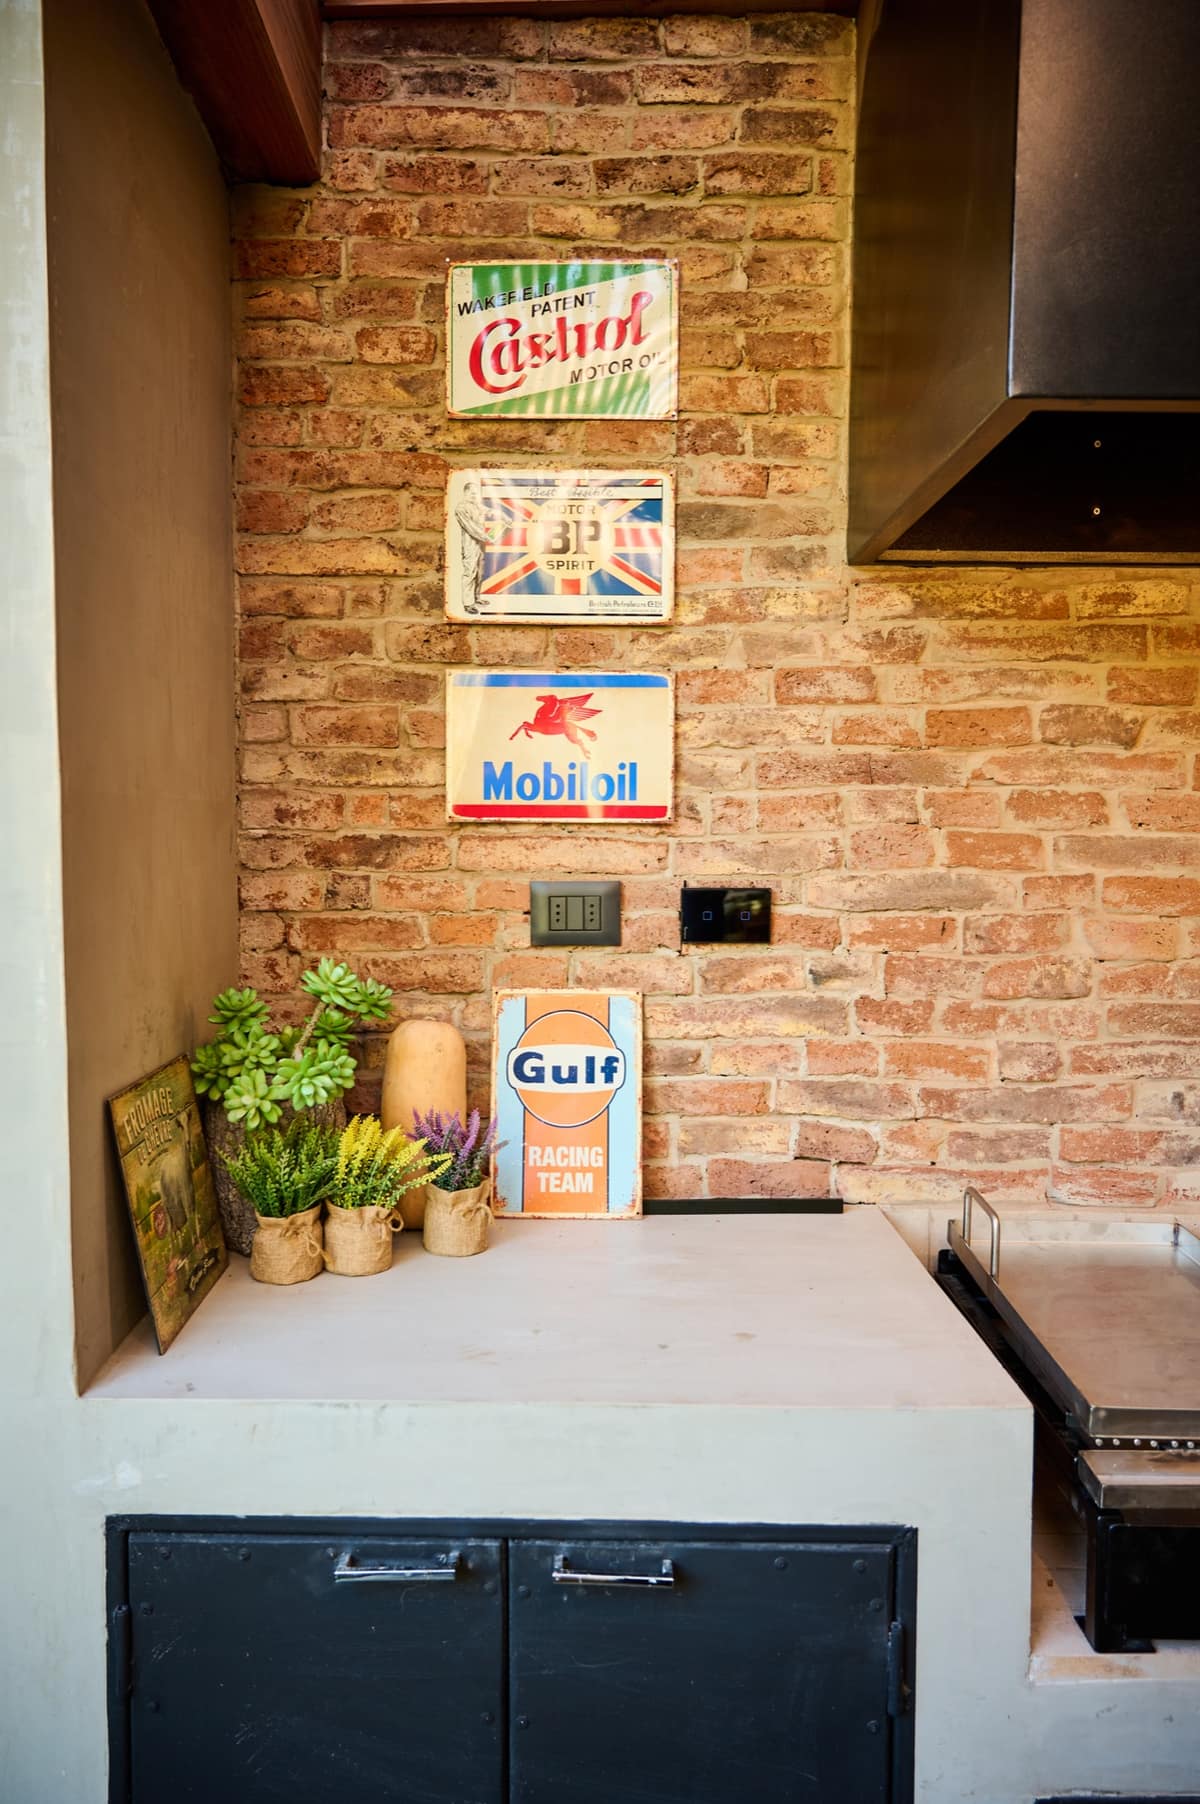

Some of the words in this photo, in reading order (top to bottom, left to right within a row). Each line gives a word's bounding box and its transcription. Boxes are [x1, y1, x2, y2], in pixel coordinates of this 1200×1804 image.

[458, 283, 554, 316] WAKEFIELD
[531, 291, 596, 317] PATENT
[468, 291, 653, 394] Castrol
[569, 358, 633, 384] MOTOR
[546, 504, 596, 515] OTOR
[546, 561, 595, 571] SPIRIT
[483, 761, 637, 801] Mobiloil
[513, 1051, 619, 1084] Gulf
[123, 1087, 174, 1145] FROMAGE
[528, 1146, 604, 1168] RACING
[537, 1172, 593, 1193] TEAM
